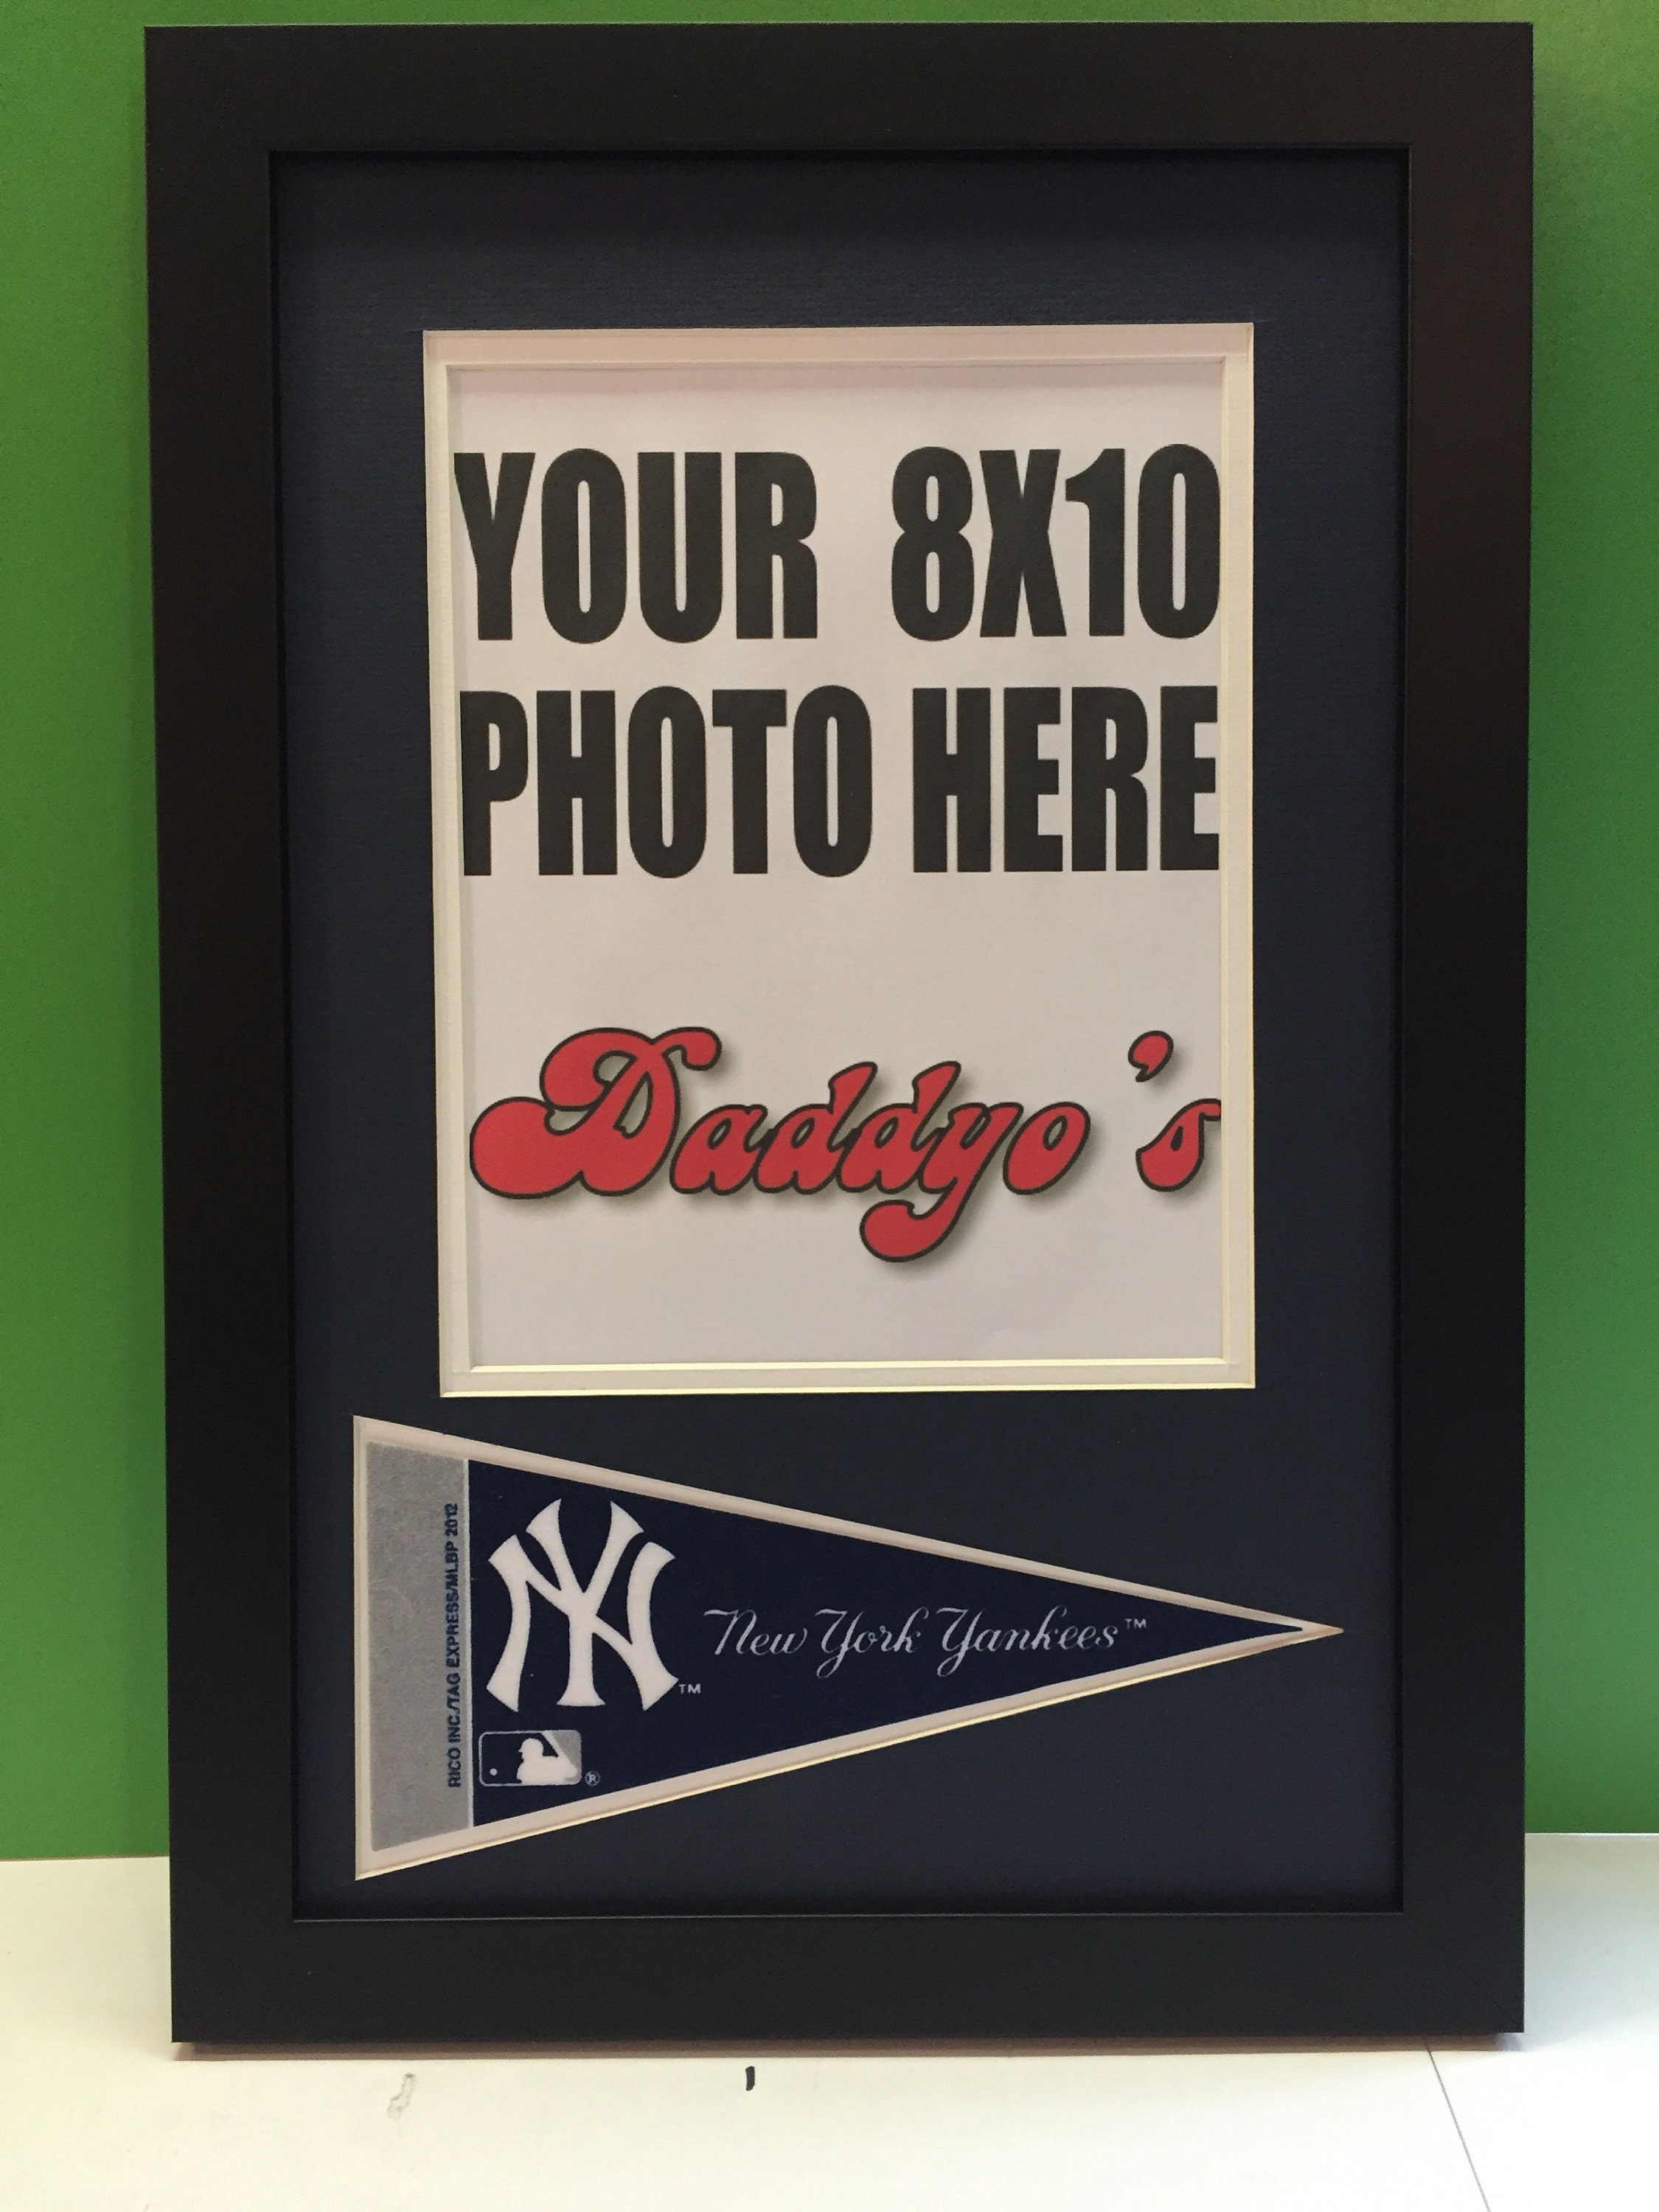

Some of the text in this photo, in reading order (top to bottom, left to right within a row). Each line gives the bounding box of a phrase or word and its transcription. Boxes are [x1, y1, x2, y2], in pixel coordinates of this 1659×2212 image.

[454, 444, 1221, 644] YOUR 8X10
[460, 685, 1220, 879] PHOTO HERE
[469, 1026, 1221, 1263] Daddyo's
[444, 1502, 459, 1537] 2012
[444, 1540, 460, 1669] EXPRESS/MLBP
[703, 1608, 808, 1656] New
[814, 1606, 930, 1678] York
[936, 1604, 1119, 1677] Yankees
[447, 1747, 462, 1789] RICO
